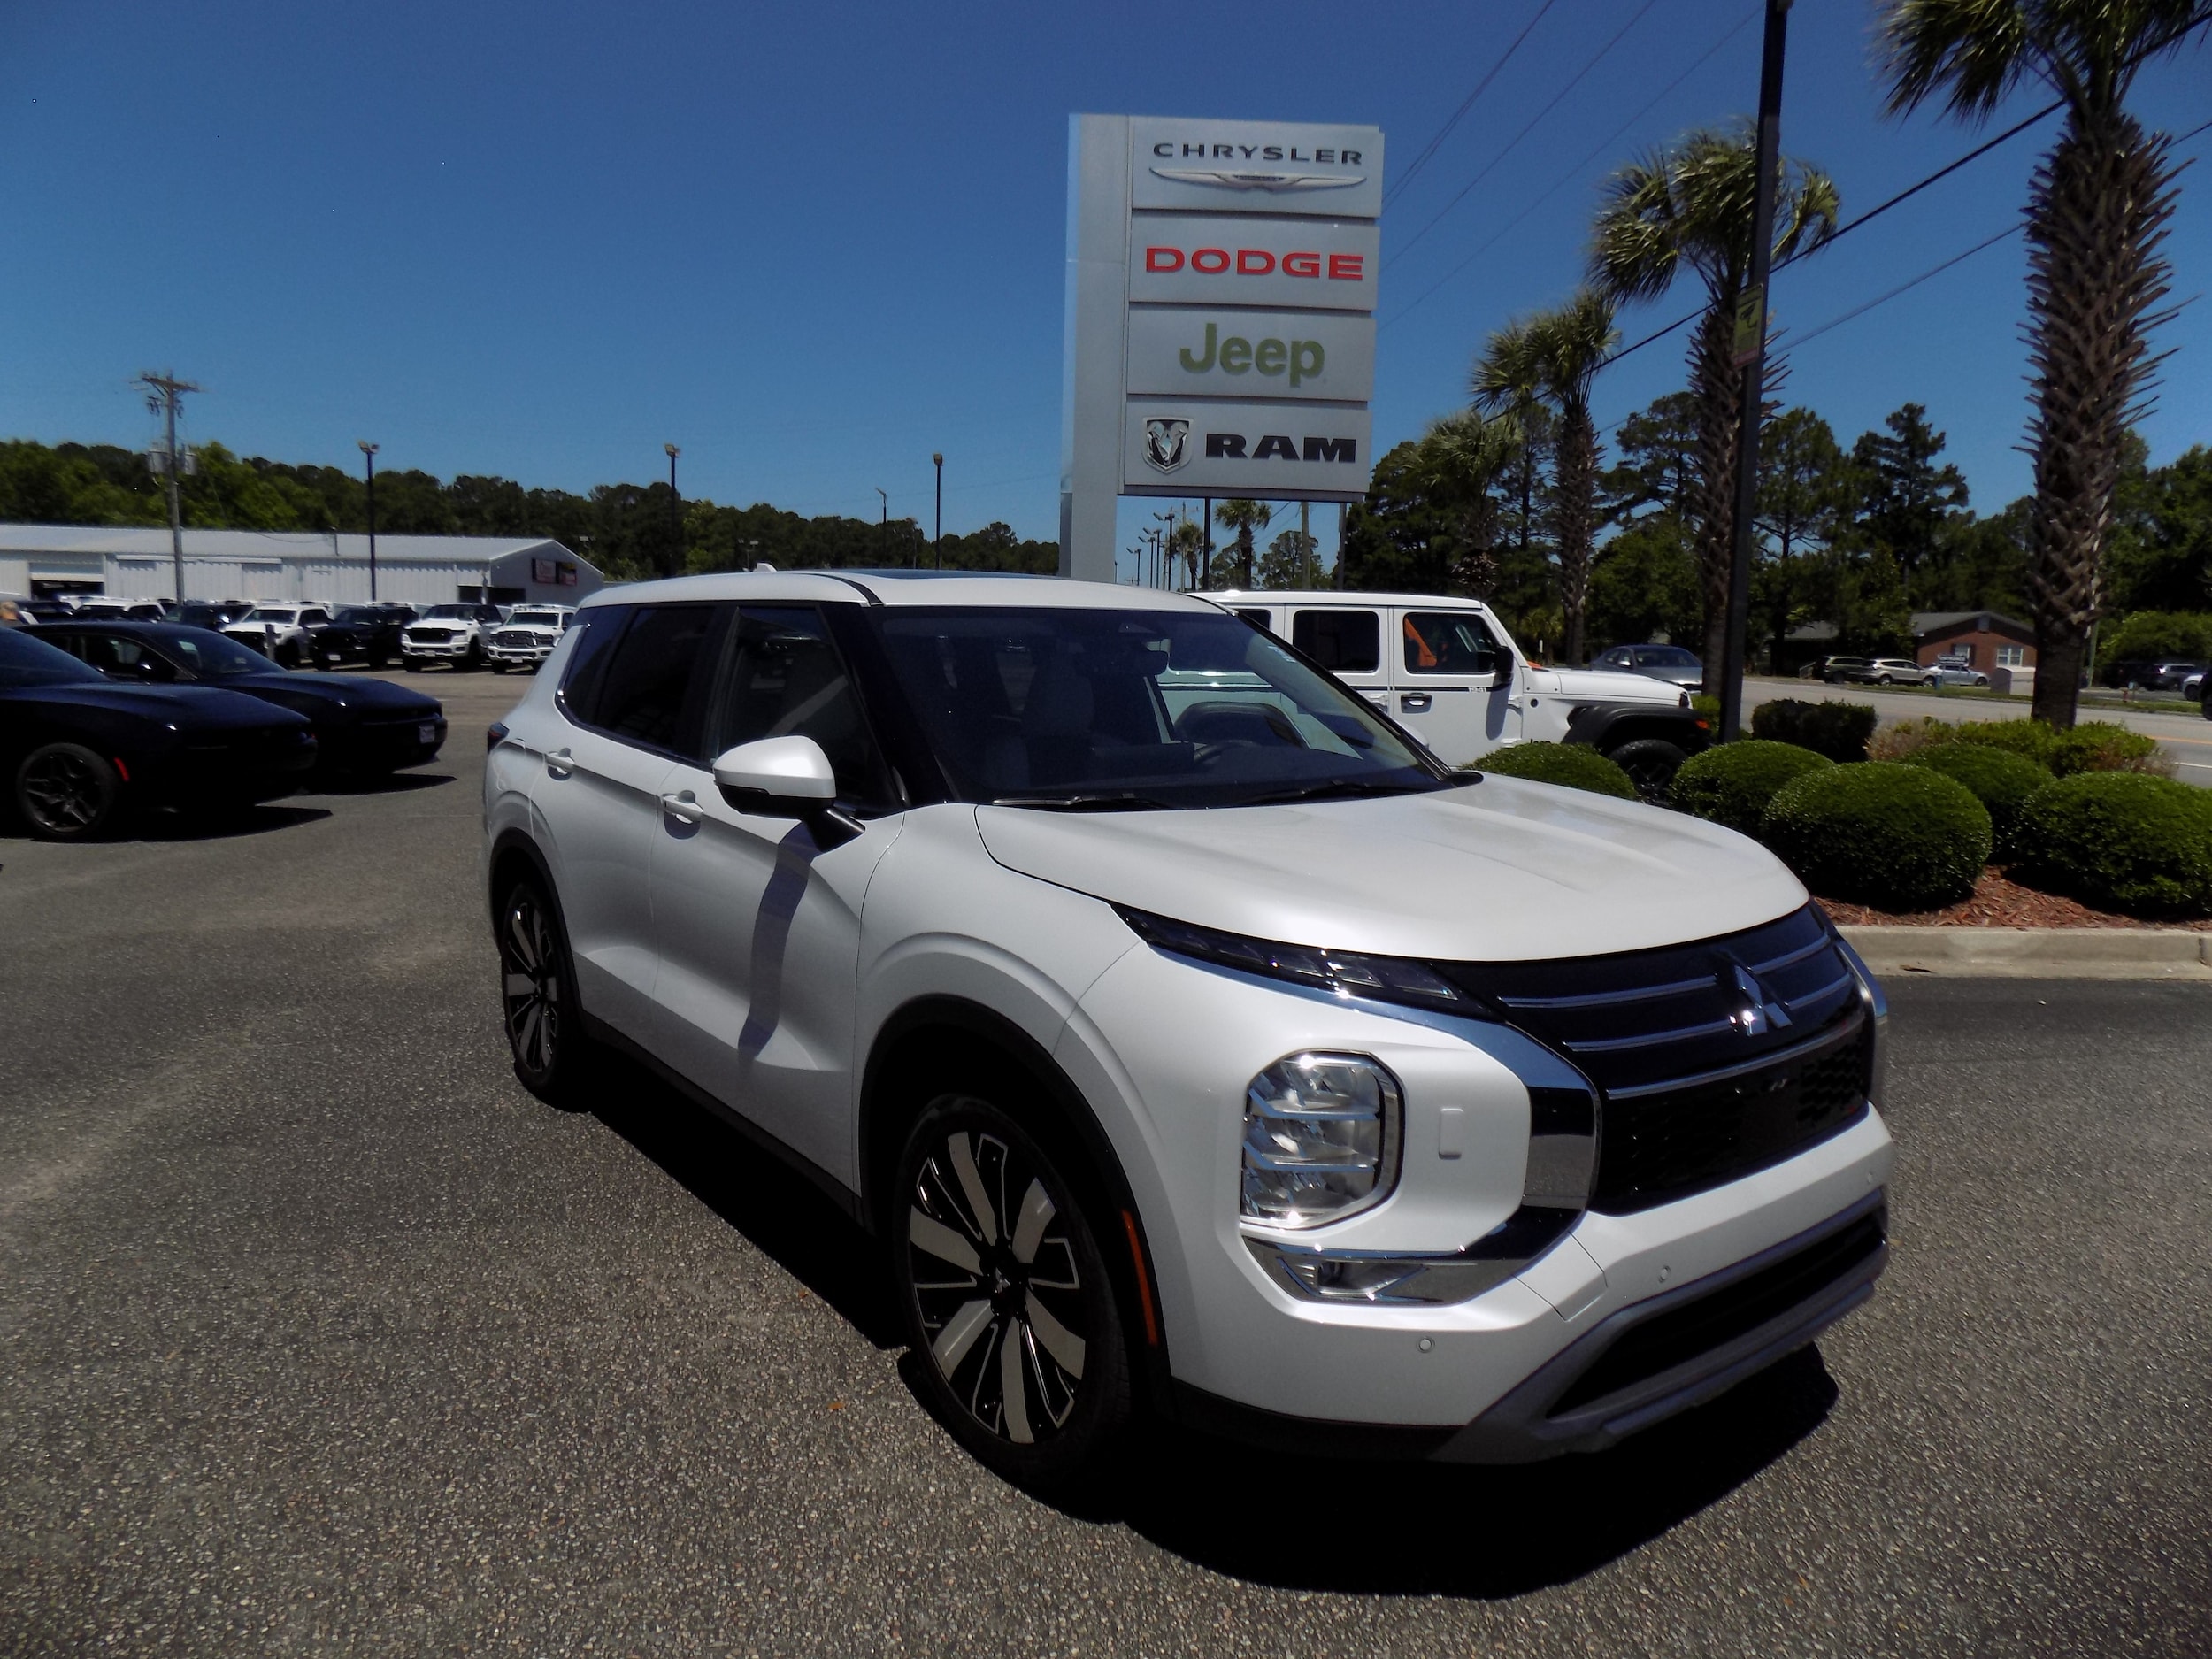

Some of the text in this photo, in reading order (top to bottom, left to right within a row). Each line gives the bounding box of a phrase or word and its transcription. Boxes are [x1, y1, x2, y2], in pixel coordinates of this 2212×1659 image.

[1153, 142, 1363, 165] CHRYSLER
[1146, 247, 1364, 281] DODGE
[1179, 322, 1325, 388] Jeep
[1205, 434, 1356, 463] RAM
